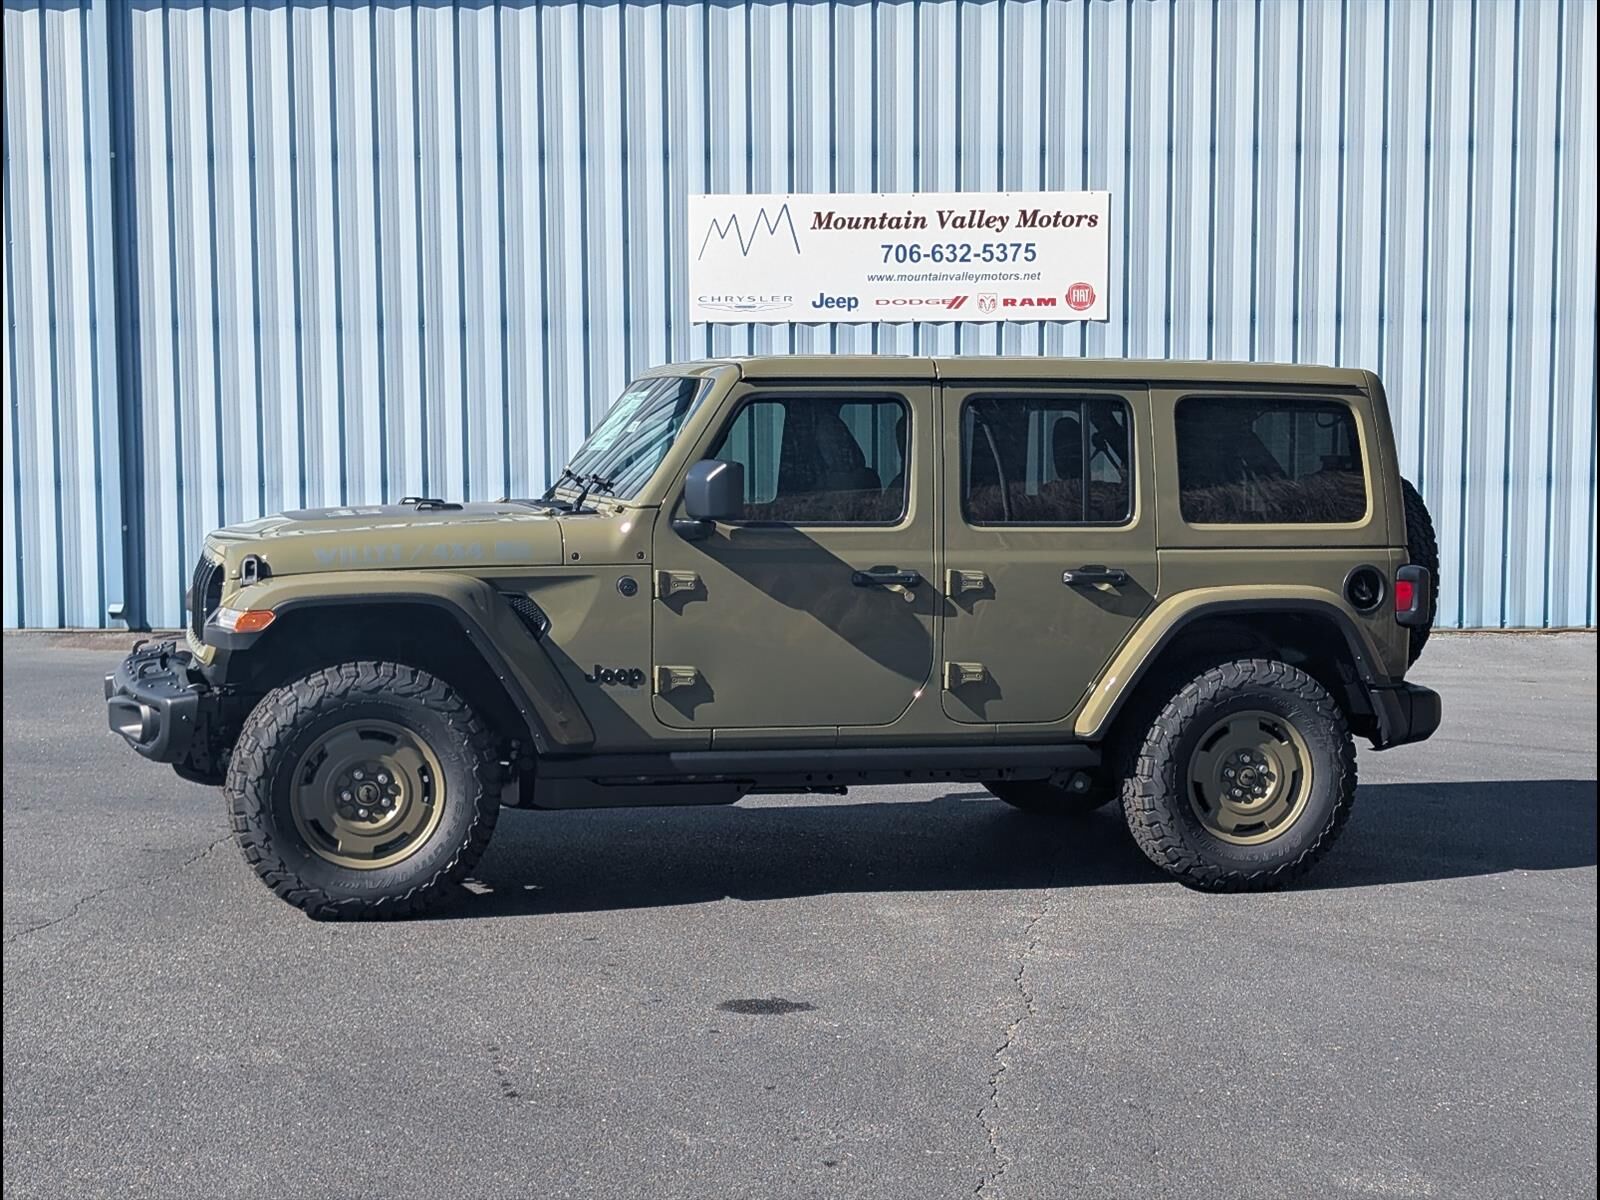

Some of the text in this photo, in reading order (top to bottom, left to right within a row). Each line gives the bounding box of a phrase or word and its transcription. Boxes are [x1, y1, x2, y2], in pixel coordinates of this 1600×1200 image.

[810, 209, 1099, 233] Mountain Valley Motors
[881, 243, 1037, 263] 706-632-5375
[867, 271, 1042, 284] www.mountainvalleymotors.net
[697, 295, 794, 303] CHRYSLER
[811, 292, 859, 312] Jeep
[875, 298, 953, 306] DODGE
[1003, 297, 1057, 308] RAM
[1072, 289, 1090, 304] FIAT
[584, 664, 646, 690] Jeep
